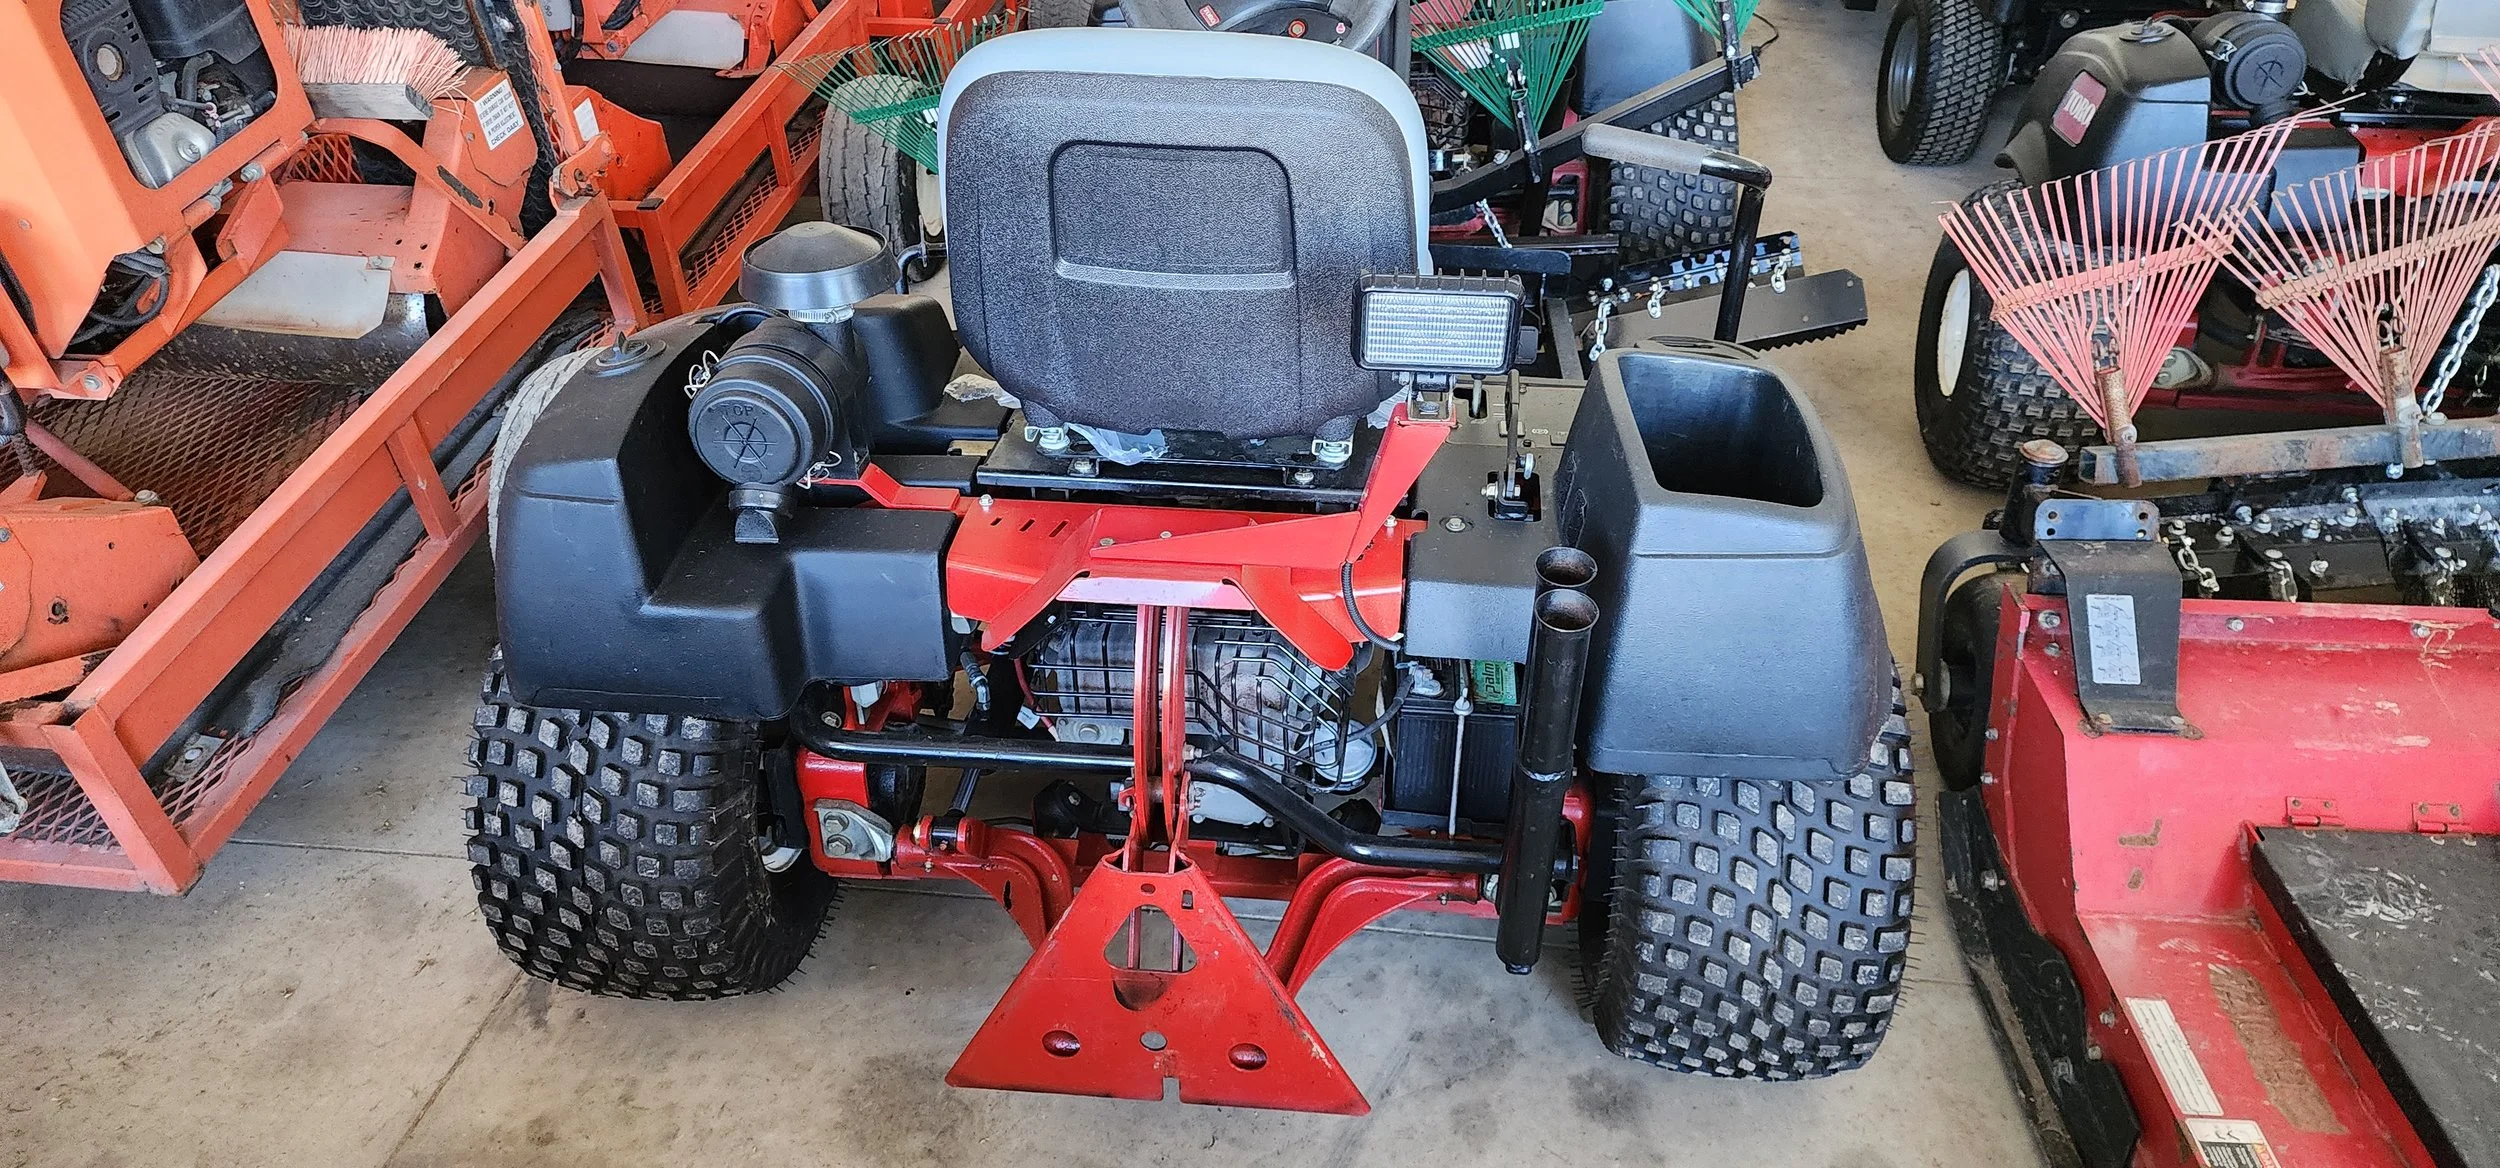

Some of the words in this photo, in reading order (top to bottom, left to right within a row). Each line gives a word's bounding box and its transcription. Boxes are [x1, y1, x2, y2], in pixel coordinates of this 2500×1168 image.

[482, 87, 503, 105] WARNING
[2062, 88, 2097, 127] TORO
[491, 130, 506, 145] CHECK
[506, 119, 519, 133] DAILY
